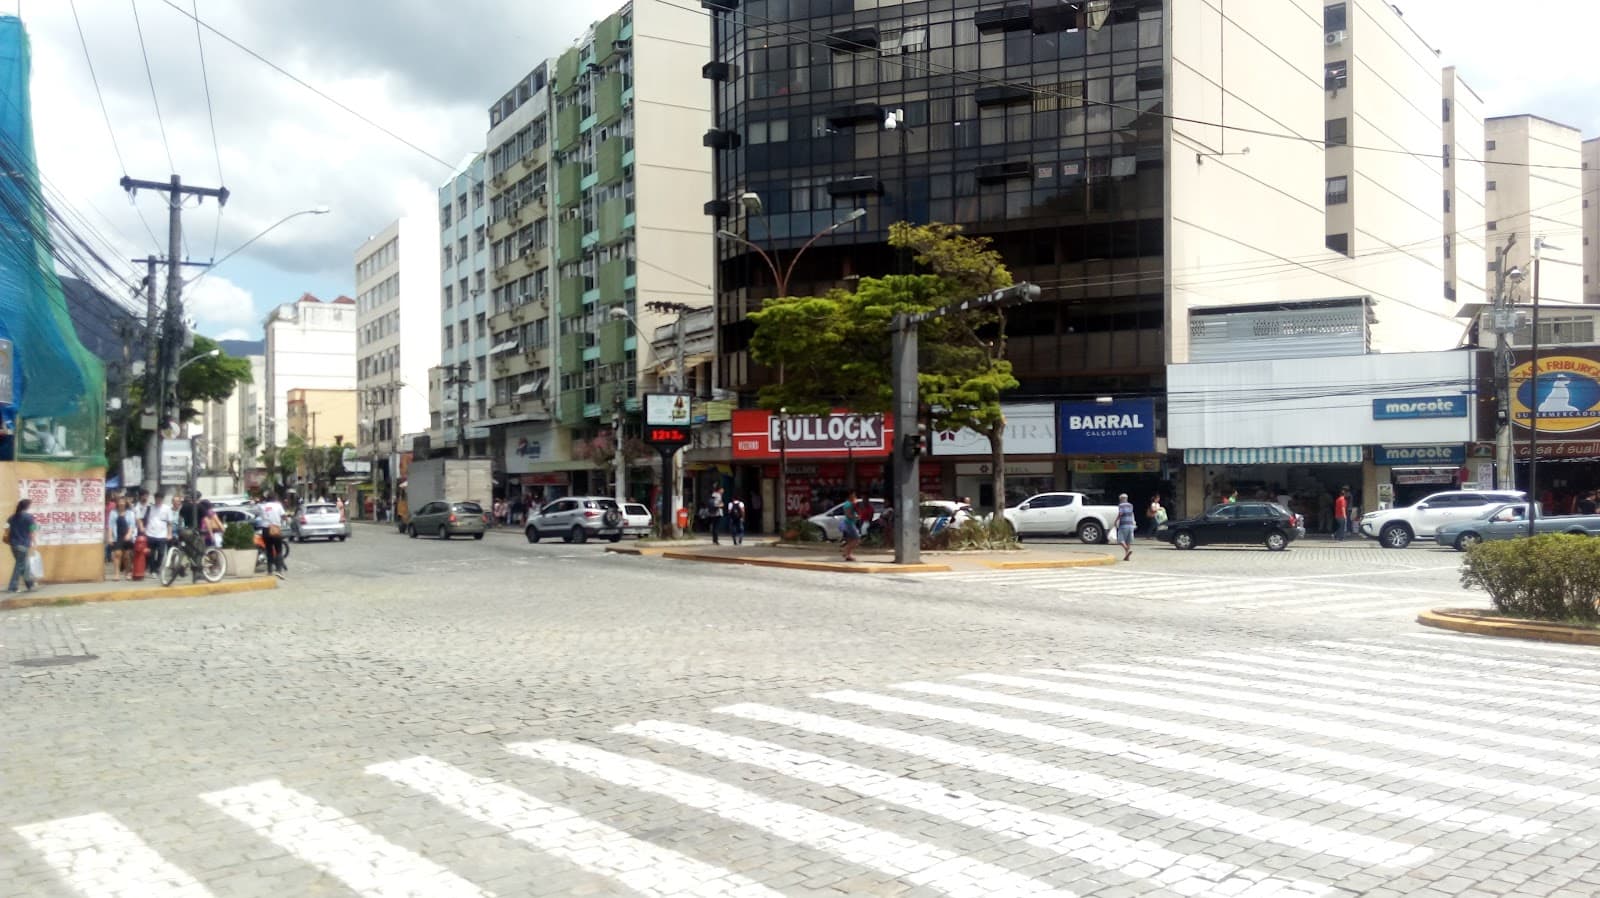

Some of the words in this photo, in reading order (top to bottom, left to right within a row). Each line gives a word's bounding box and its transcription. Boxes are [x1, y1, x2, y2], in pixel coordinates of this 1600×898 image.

[1385, 399, 1454, 413] mascote
[1516, 410, 1600, 418] SUERMERCADO
[772, 417, 877, 441] BULLOCK
[1069, 414, 1144, 430] BARRAL
[1386, 446, 1452, 459] mascote
